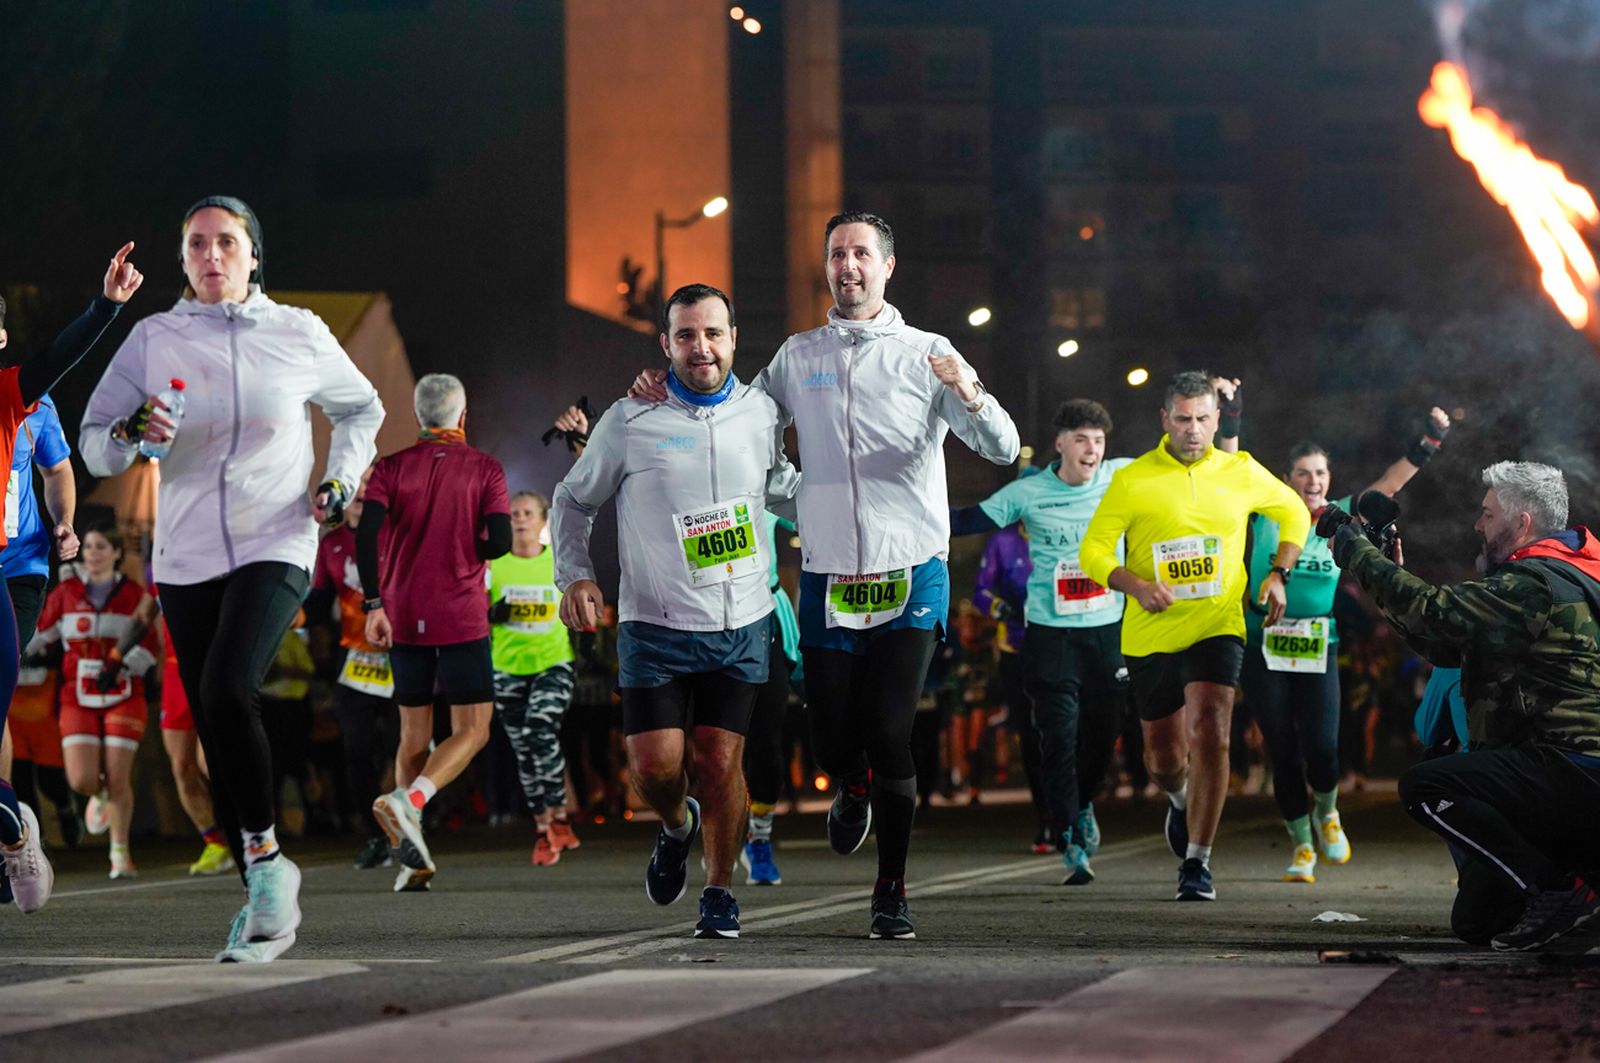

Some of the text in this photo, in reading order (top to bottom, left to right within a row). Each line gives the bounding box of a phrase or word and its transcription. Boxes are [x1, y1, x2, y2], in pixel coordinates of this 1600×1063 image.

[695, 513, 719, 525] NOCHE
[719, 510, 728, 519] DE
[687, 526, 704, 538] SAN
[705, 519, 731, 533] ANTON
[697, 526, 747, 558] 4603
[1168, 557, 1213, 579] 9058
[837, 575, 855, 583] SAN
[842, 583, 896, 606] 4604
[512, 604, 548, 617] 2570
[1272, 635, 1320, 654] 12634
